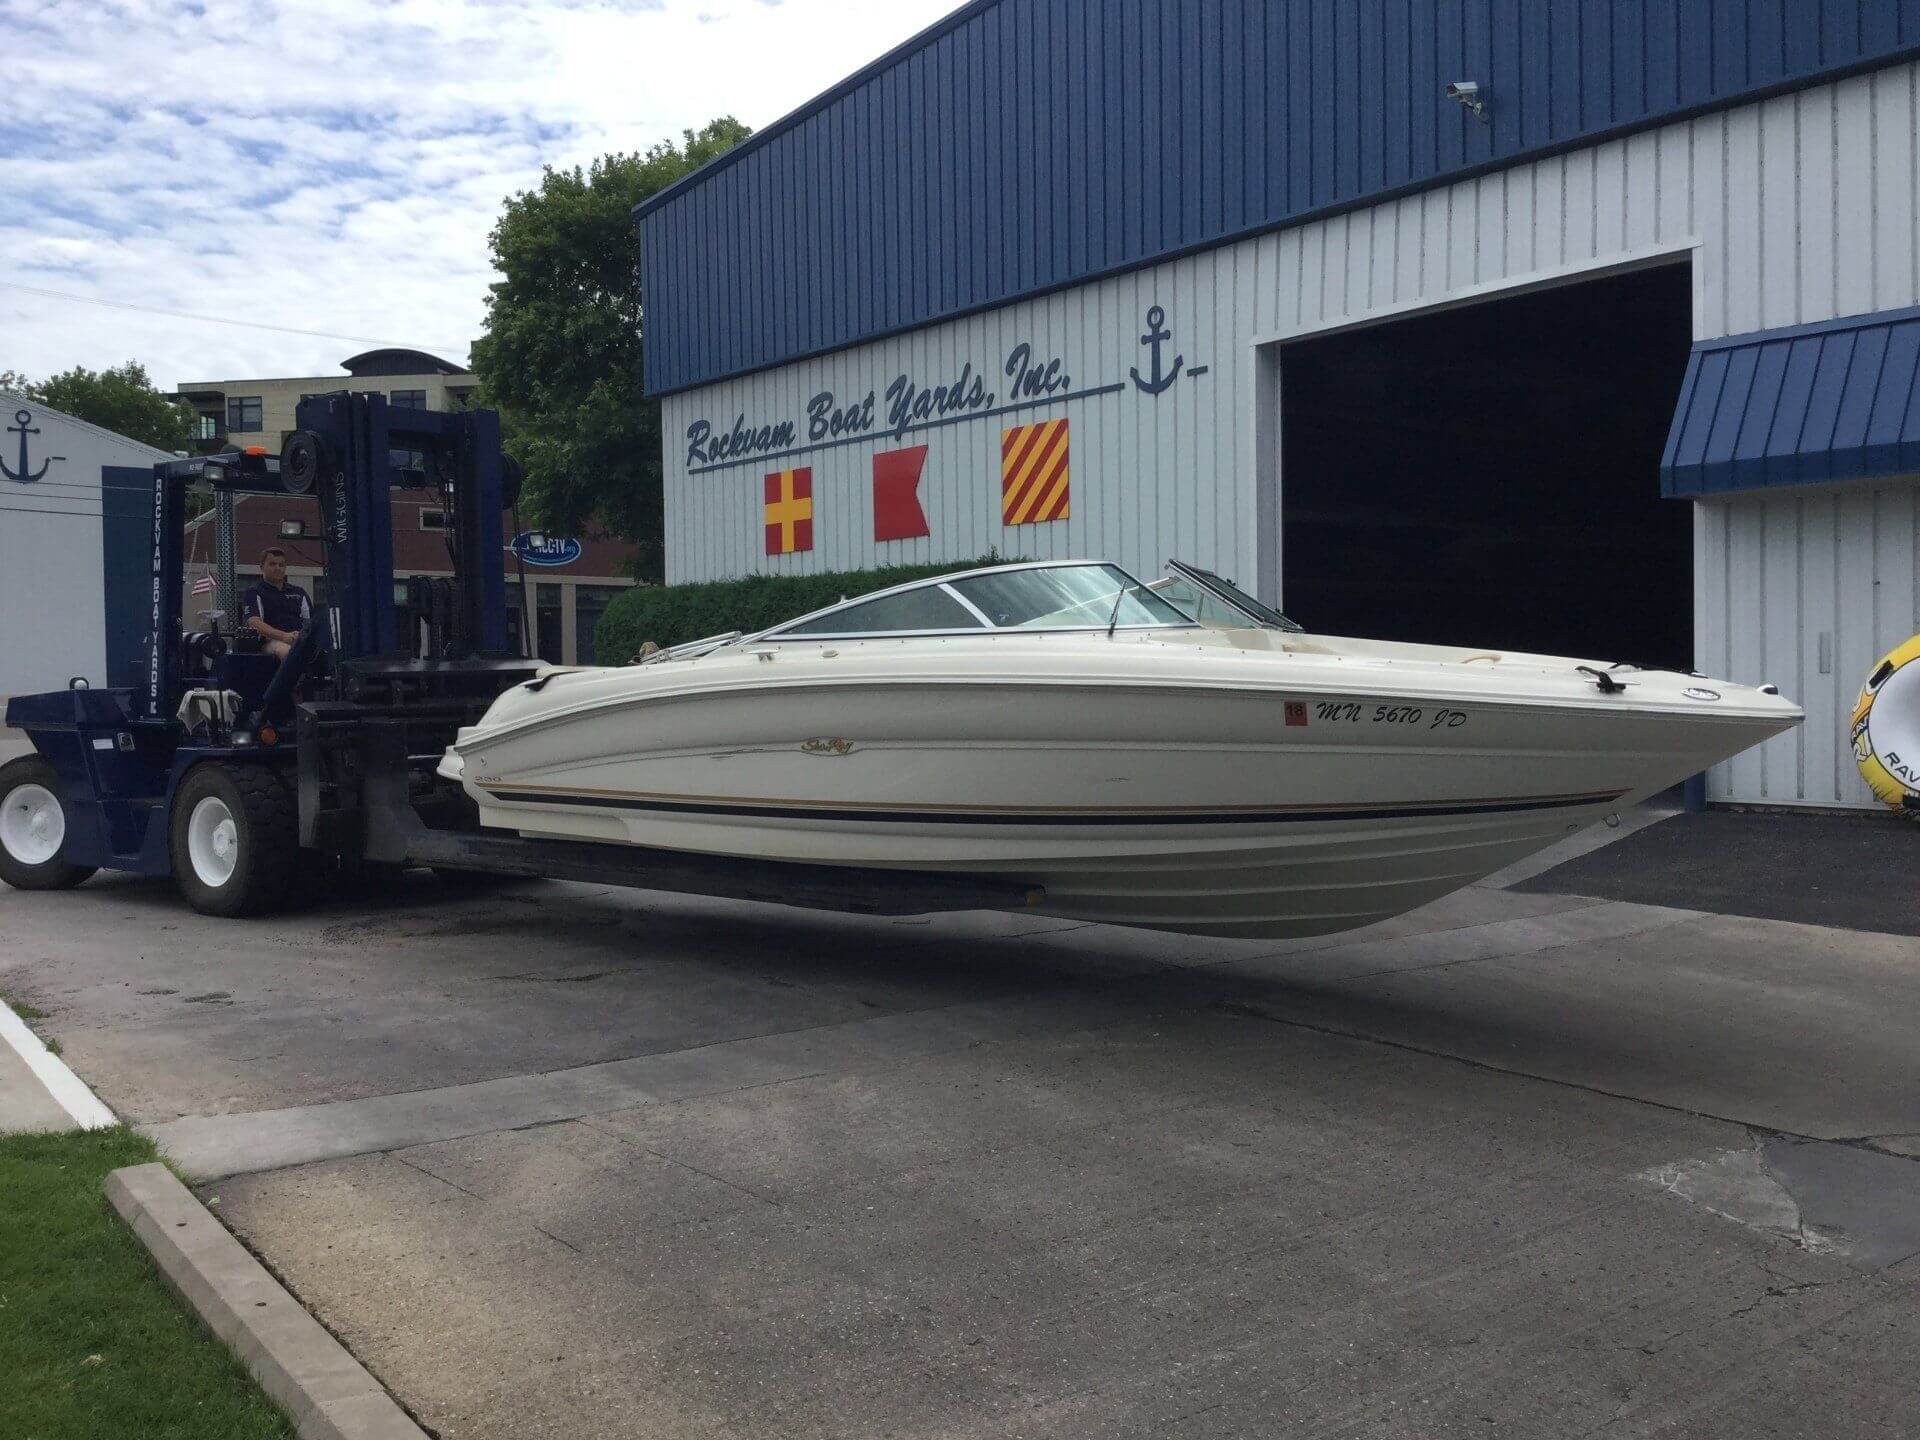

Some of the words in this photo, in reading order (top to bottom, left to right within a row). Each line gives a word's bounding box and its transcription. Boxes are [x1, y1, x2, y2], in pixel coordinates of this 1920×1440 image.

[687, 412, 796, 466] Rockvam
[807, 391, 875, 441] Boat
[886, 361, 995, 441] Yards,
[1005, 342, 1070, 400] Inc.
[153, 478, 162, 572] ROCKVAM
[151, 631, 159, 697] YARDS
[1287, 703, 1303, 716] 18
[1316, 702, 1362, 722] MN
[1373, 706, 1423, 724] 5670
[1429, 709, 1467, 729] JD
[1883, 751, 1920, 783] RAV
